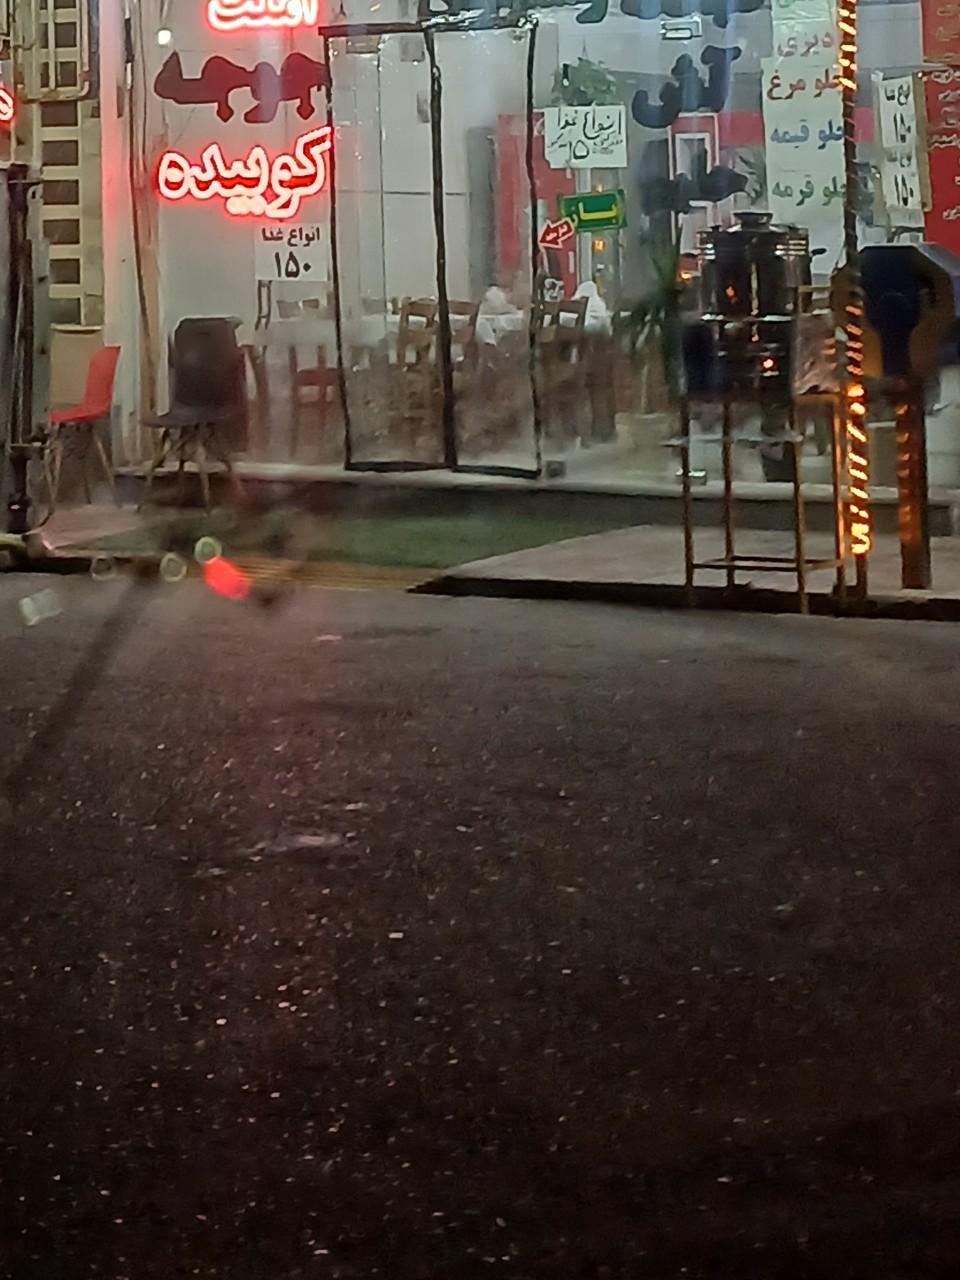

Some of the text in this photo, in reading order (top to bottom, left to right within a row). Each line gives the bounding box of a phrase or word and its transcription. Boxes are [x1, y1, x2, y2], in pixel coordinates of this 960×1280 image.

[157, 127, 332, 219] کوبیده
[287, 225, 320, 248] انواع
[274, 250, 312, 278] ۱۵۰
